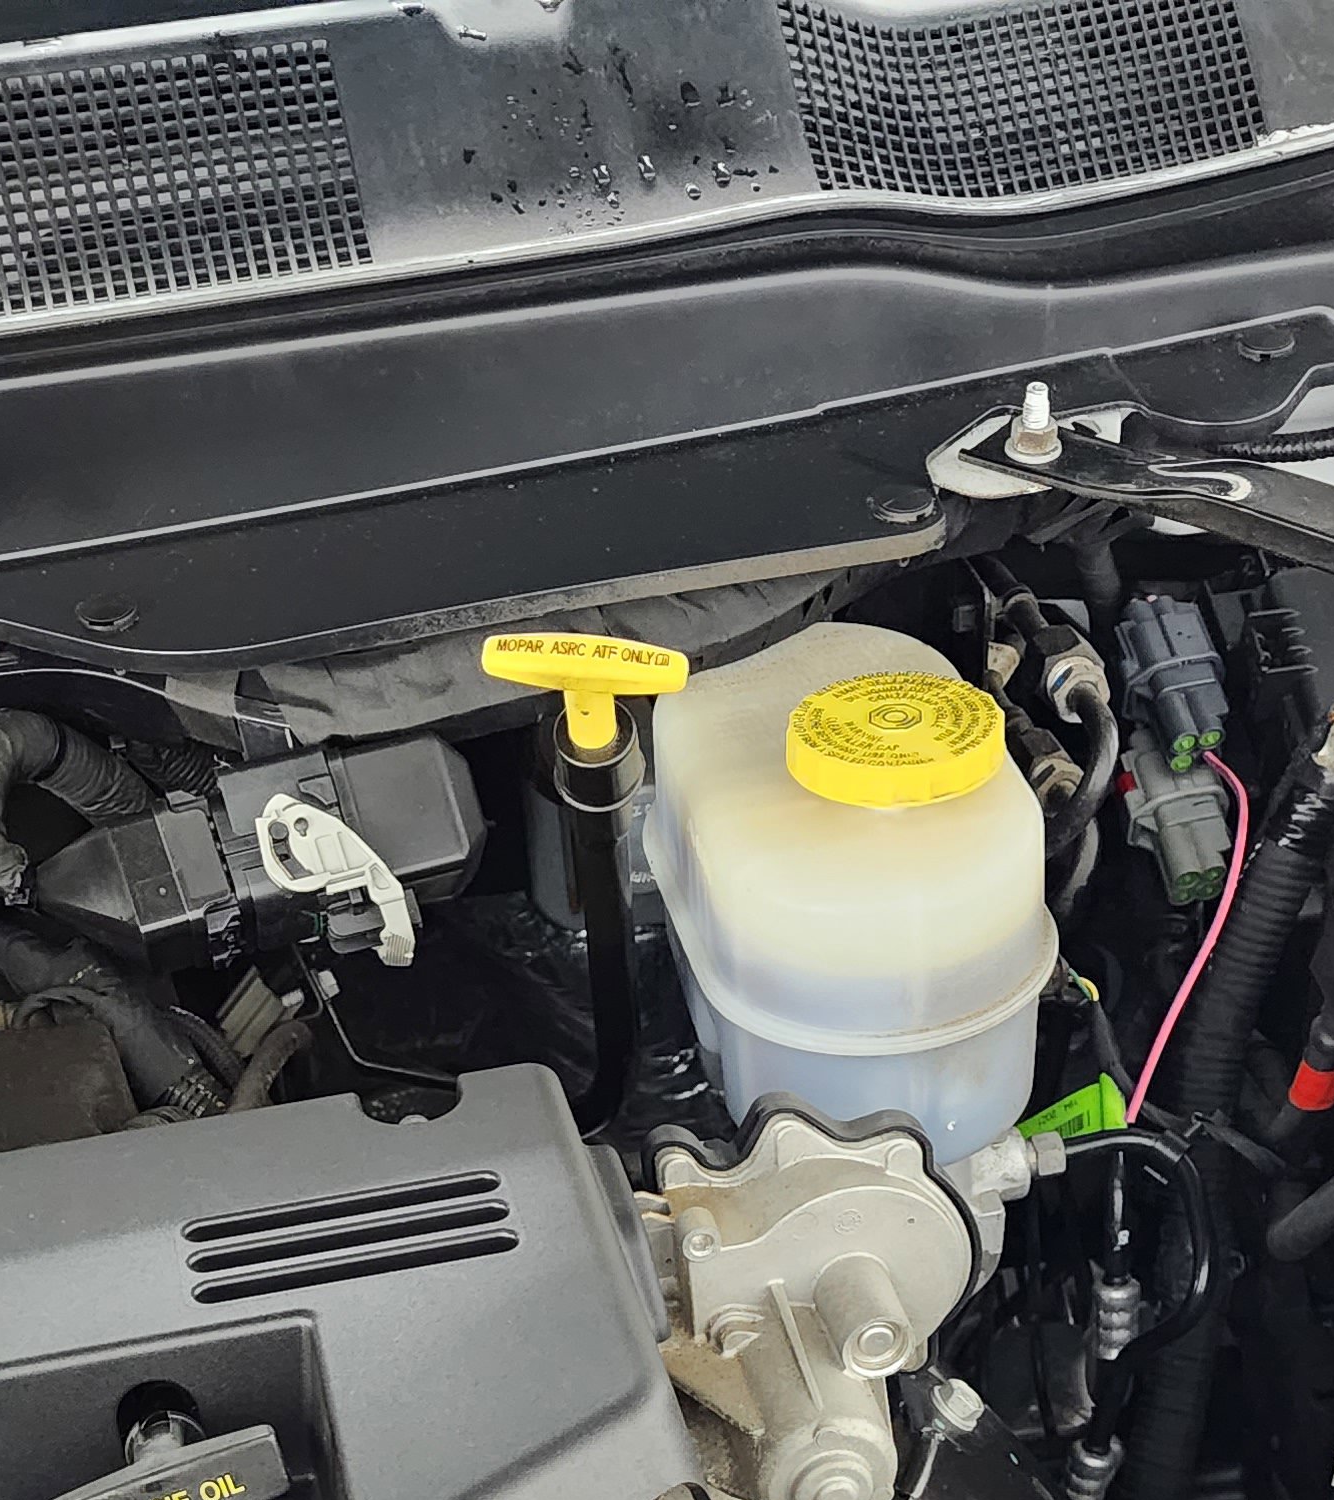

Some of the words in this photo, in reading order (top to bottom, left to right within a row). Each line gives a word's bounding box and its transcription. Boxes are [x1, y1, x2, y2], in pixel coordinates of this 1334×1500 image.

[497, 639, 544, 654] MOPAR
[551, 641, 586, 656] ASRC
[592, 645, 618, 659] ATF
[621, 648, 655, 665] ONLY
[874, 743, 900, 751] CAP
